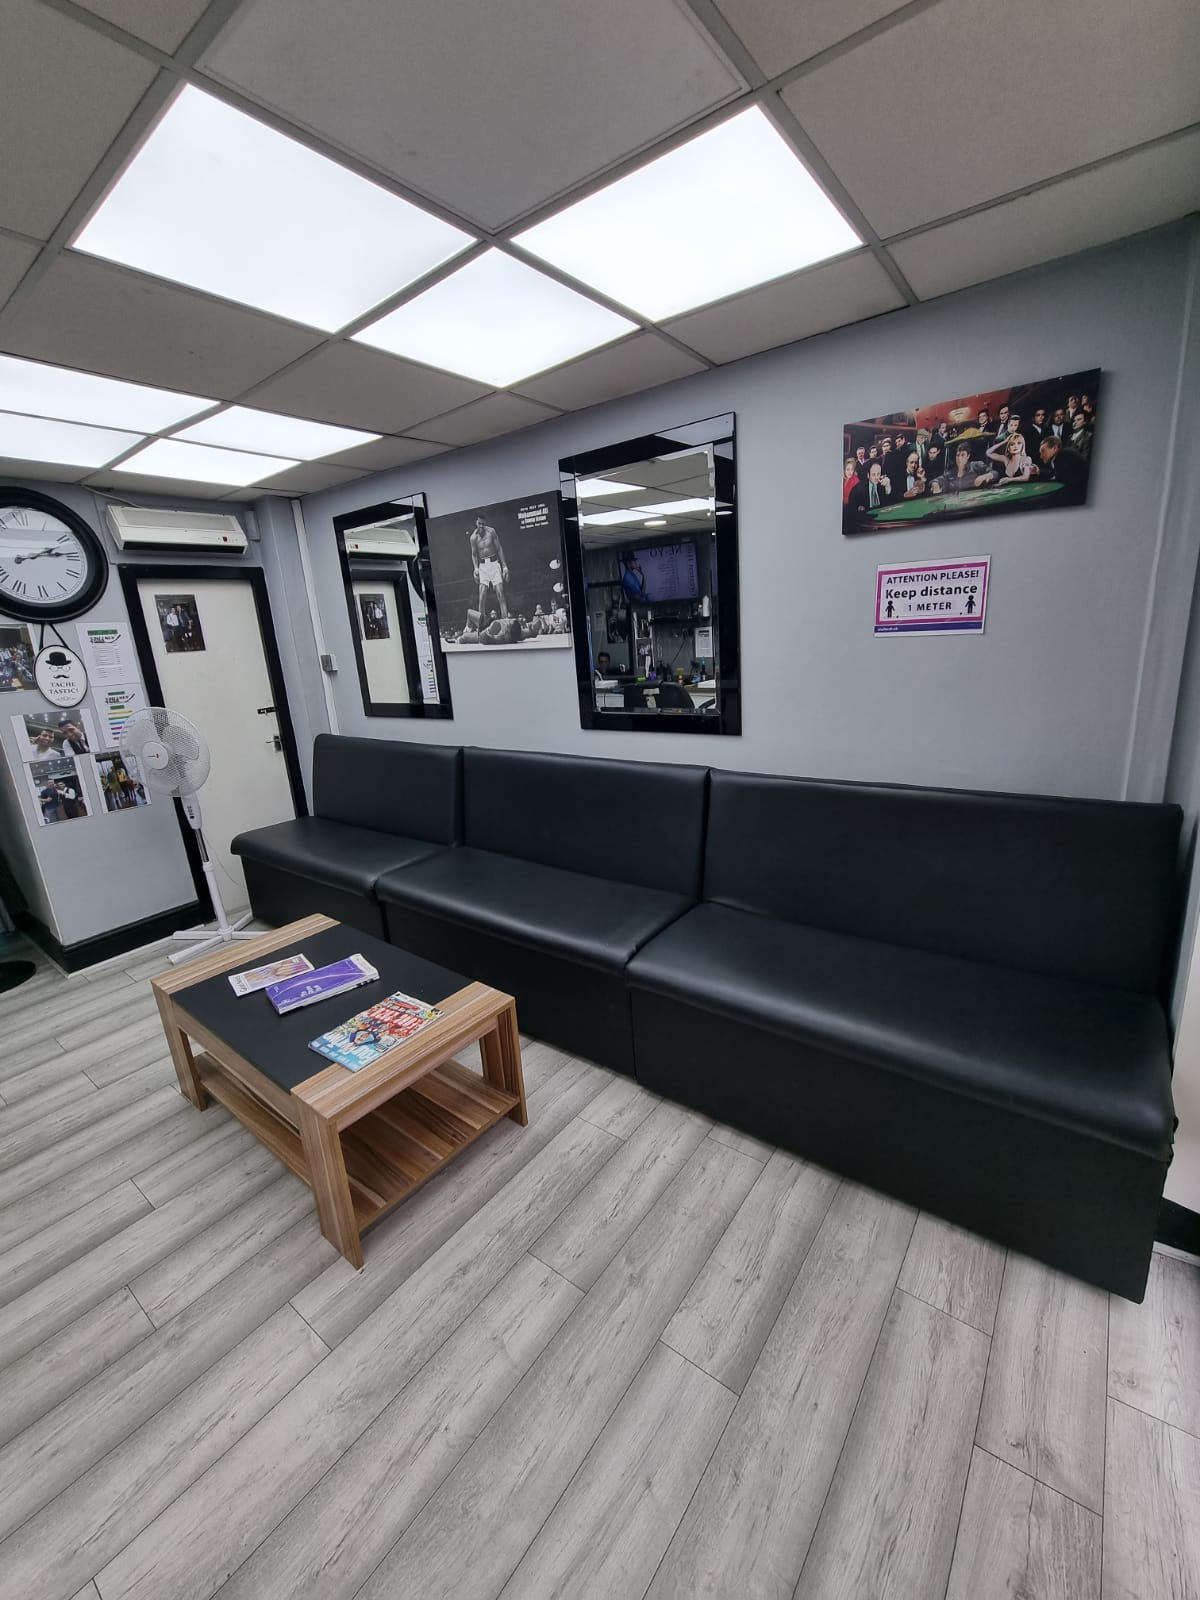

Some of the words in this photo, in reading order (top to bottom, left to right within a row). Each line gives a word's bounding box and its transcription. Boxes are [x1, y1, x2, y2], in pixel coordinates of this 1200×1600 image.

[887, 573, 938, 584] ATTENTION
[940, 570, 979, 579] PLEASE!
[885, 589, 917, 600] Keep
[920, 585, 978, 597] distance
[916, 602, 952, 611] METER
